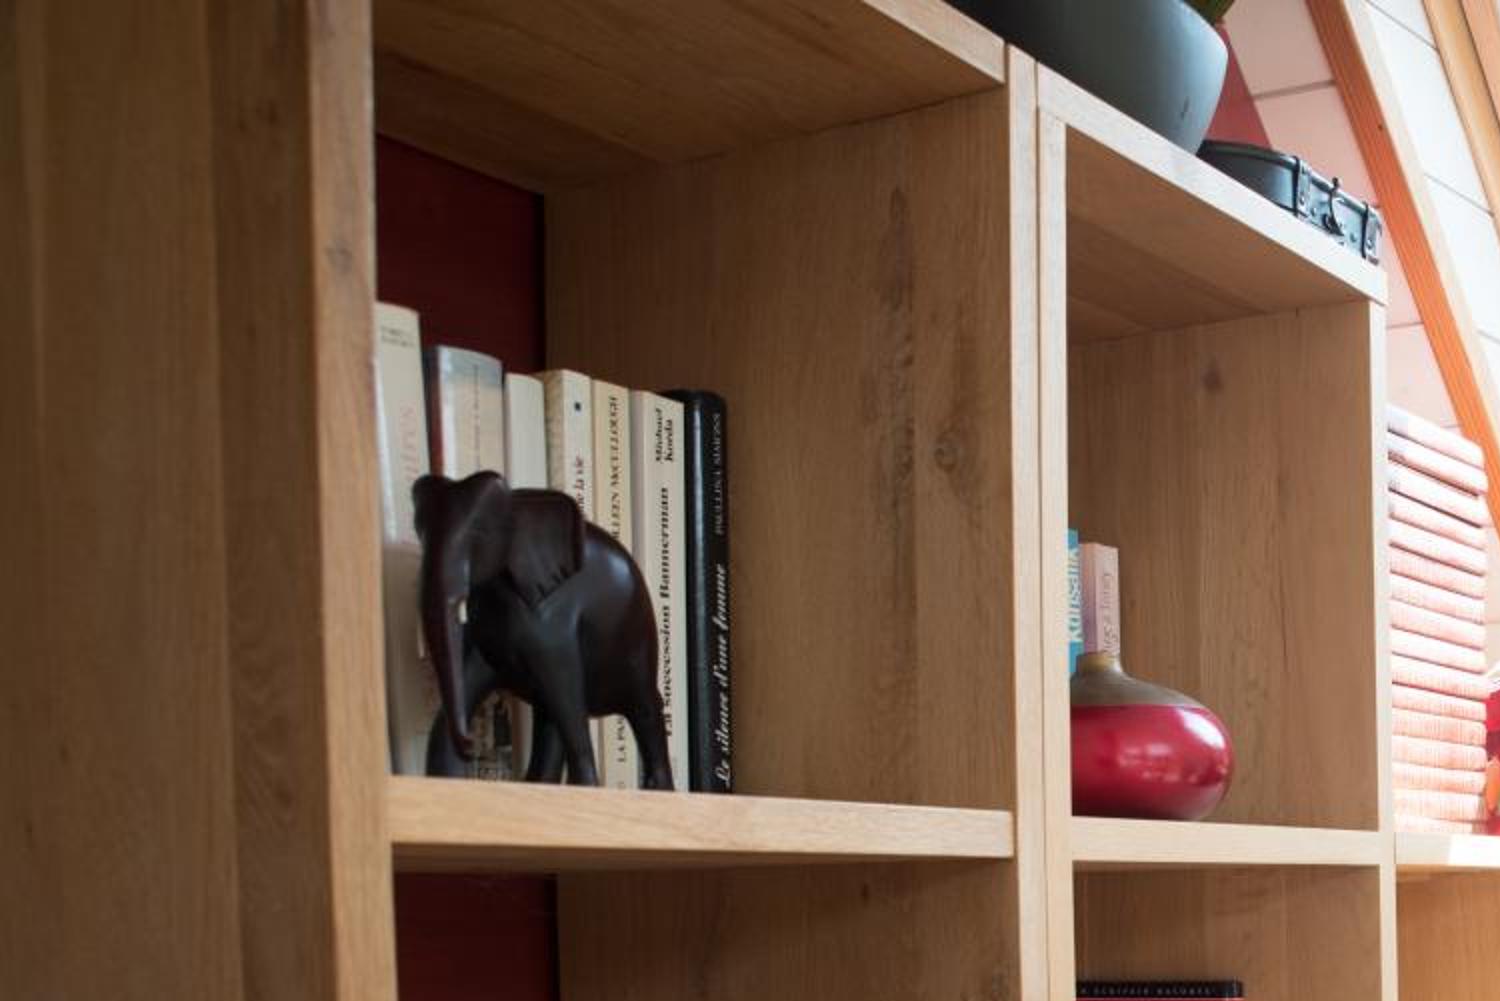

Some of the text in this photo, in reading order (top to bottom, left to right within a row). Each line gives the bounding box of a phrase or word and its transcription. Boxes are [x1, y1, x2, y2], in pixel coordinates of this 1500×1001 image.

[657, 487, 673, 601] Bannerman
[712, 562, 730, 631] femme
[713, 635, 729, 687] d'une
[714, 692, 731, 755] silence
